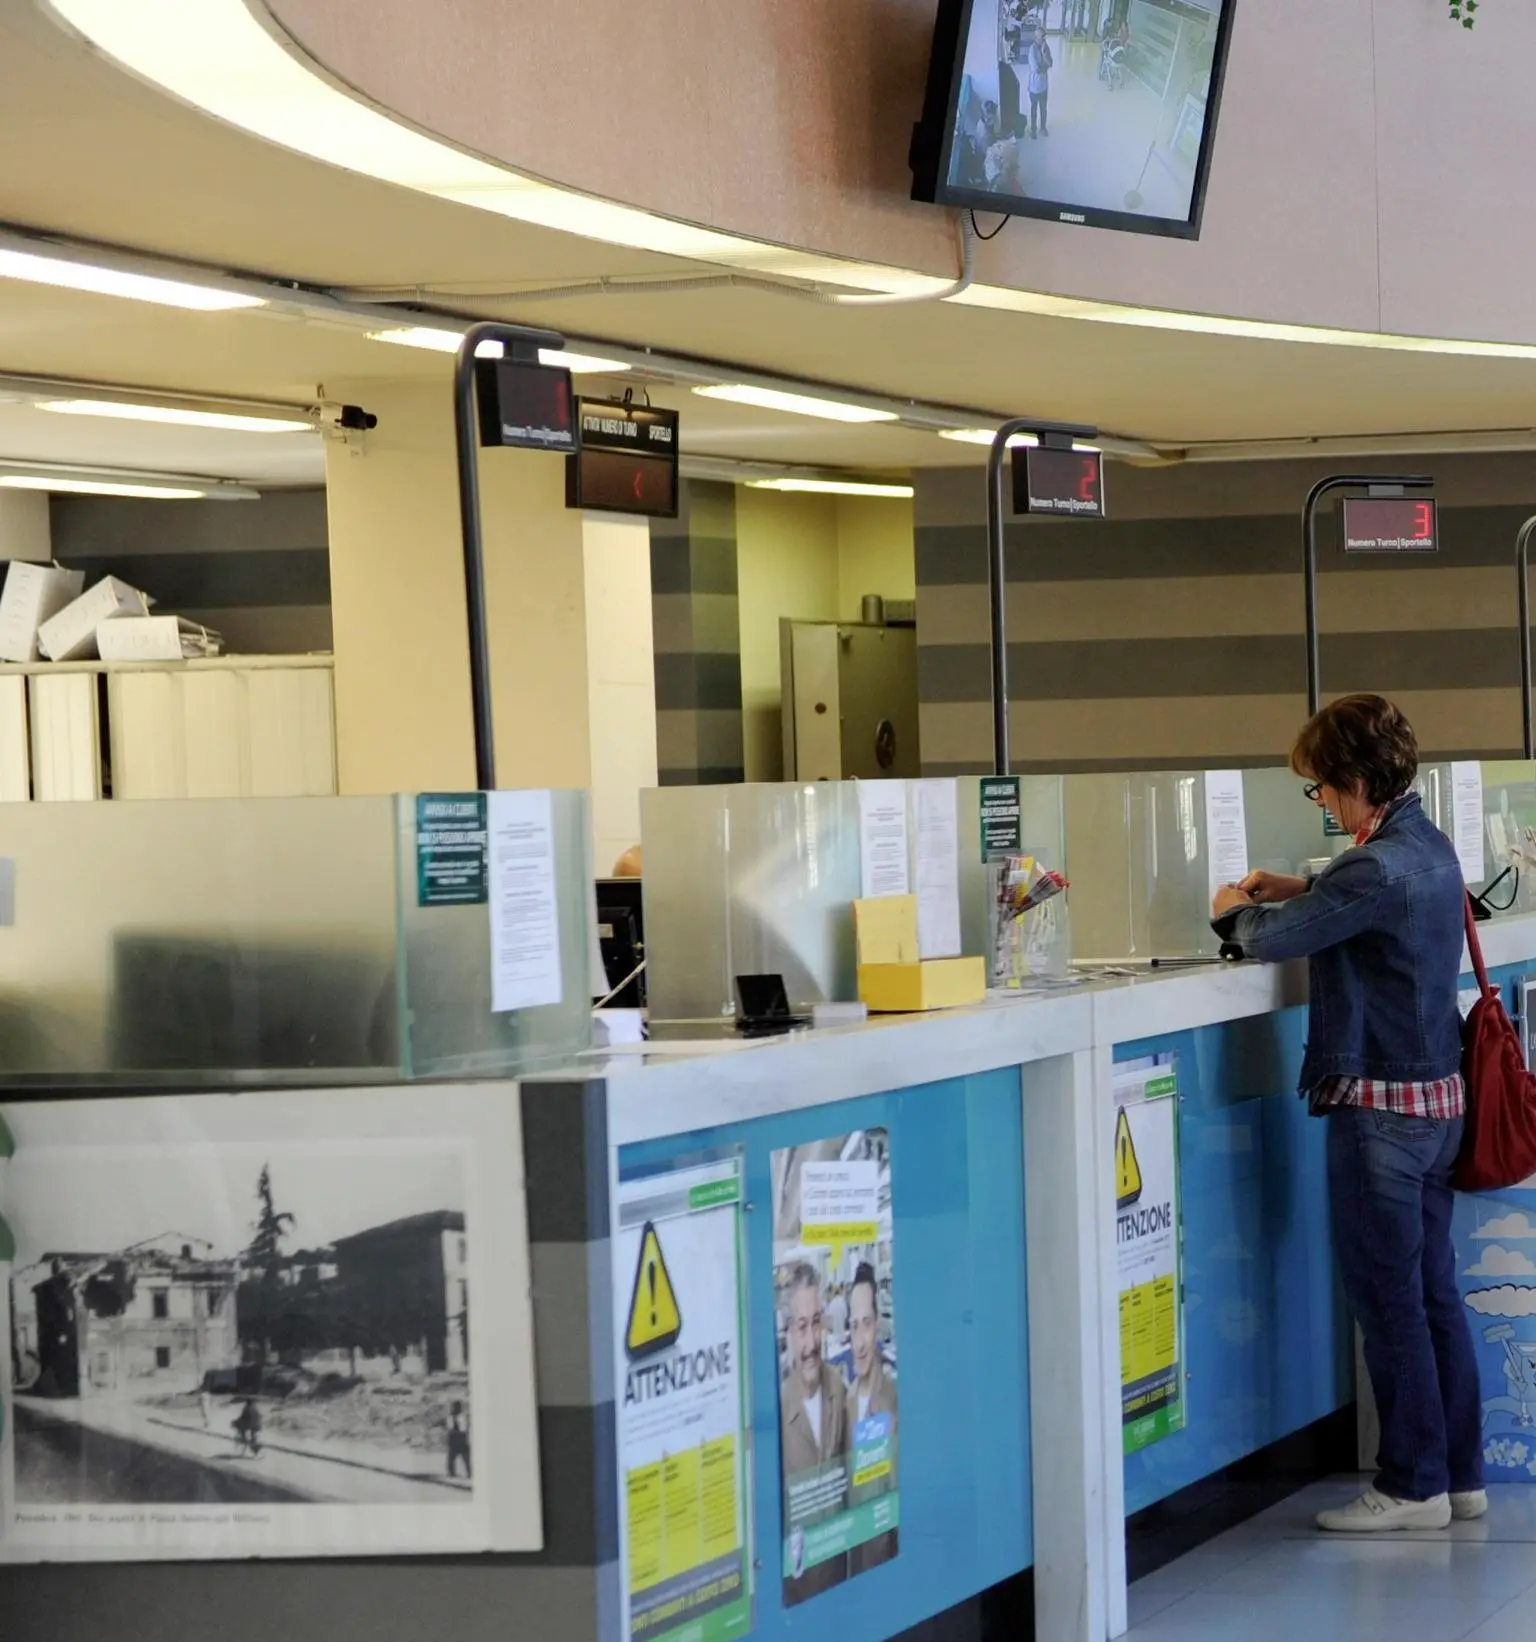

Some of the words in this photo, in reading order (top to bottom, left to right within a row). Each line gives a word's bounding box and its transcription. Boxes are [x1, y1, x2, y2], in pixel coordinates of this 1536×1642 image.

[1080, 458, 1096, 500] 2
[1030, 497, 1052, 508] Numero
[1414, 503, 1430, 538] 3
[1348, 538, 1376, 548] Numero
[1377, 538, 1397, 547] Turno
[1401, 537, 1432, 549] Sportello
[1116, 1202, 1172, 1245] TTENZIONE
[622, 1341, 731, 1409] ATTENZIONE
